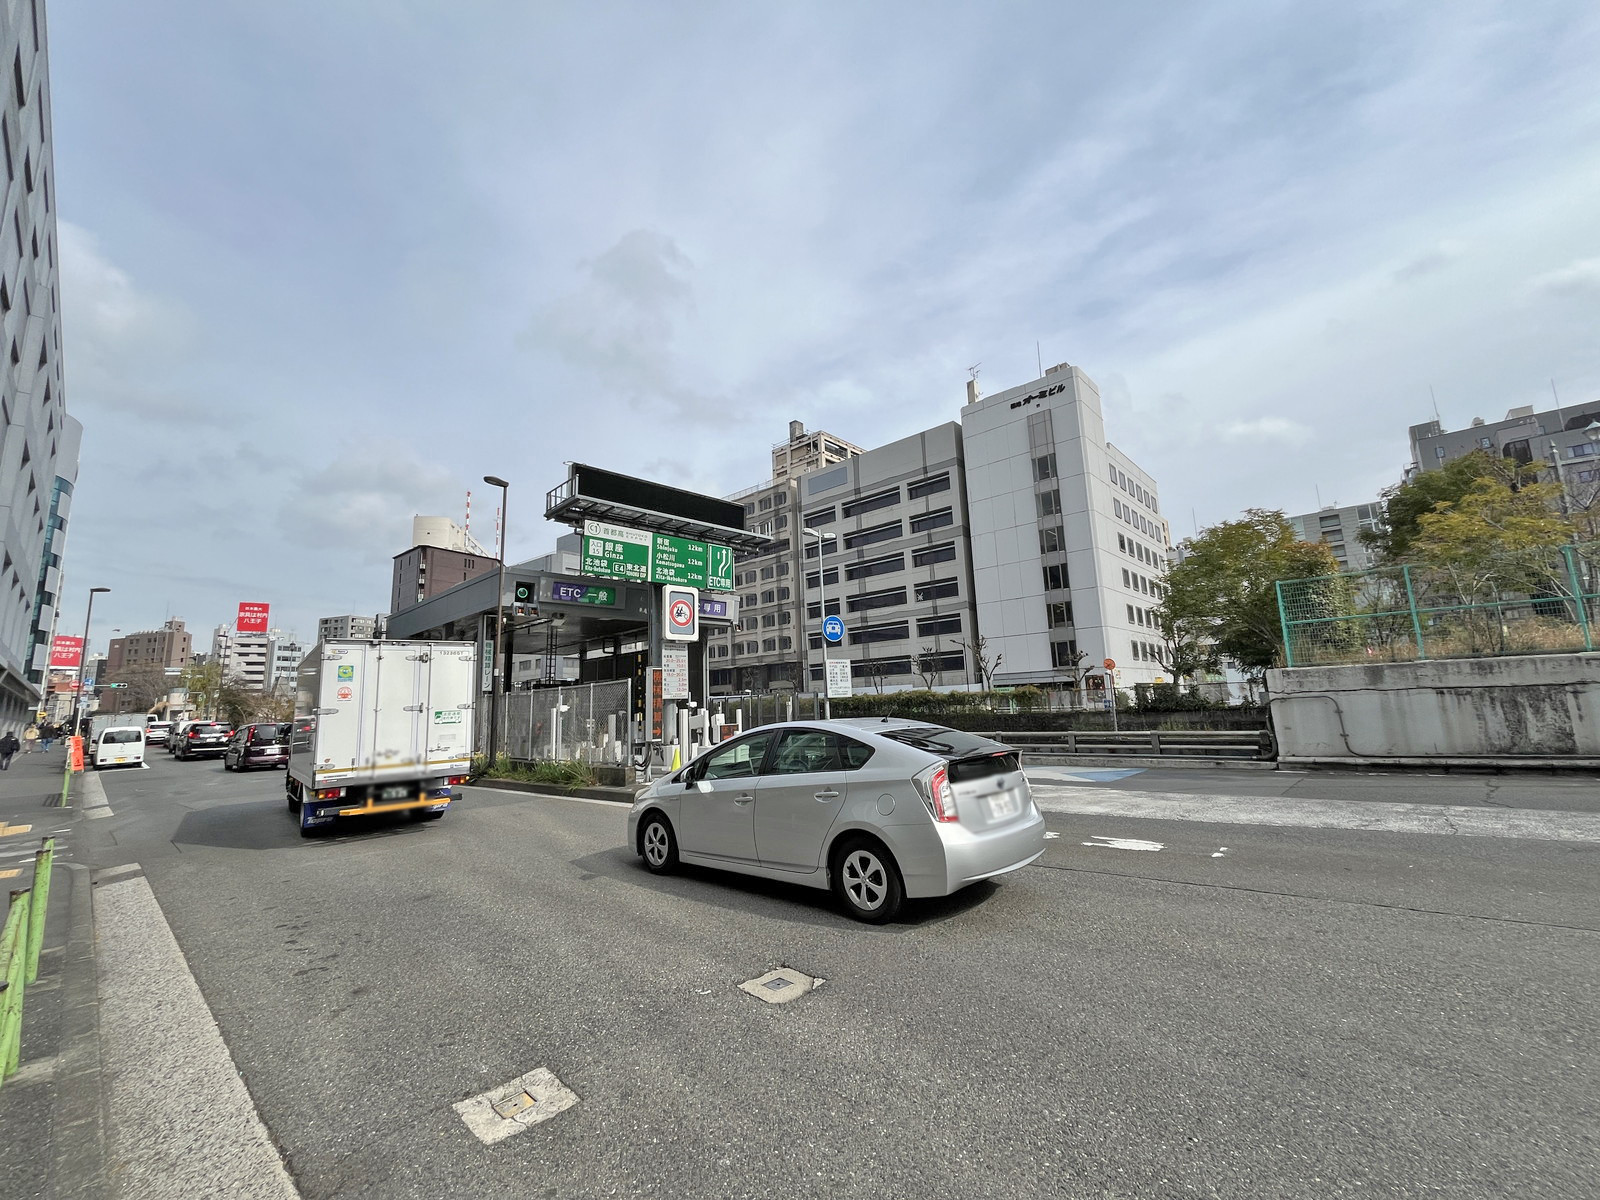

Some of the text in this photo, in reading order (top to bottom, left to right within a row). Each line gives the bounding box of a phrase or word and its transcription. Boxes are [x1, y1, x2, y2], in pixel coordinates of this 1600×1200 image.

[1023, 384, 1065, 406] オーミビル
[603, 527, 624, 538] 首都高
[657, 537, 670, 545] 新宿
[605, 541, 624, 552] 銀座
[657, 545, 678, 553] Shinjuku
[688, 544, 703, 552] 12km
[604, 551, 624, 560] Ginza
[656, 552, 676, 562] 小松川
[585, 558, 608, 568] 北池袋
[614, 564, 624, 572] E4
[626, 563, 647, 573] 東北道
[656, 567, 675, 576] 北池袋
[688, 573, 703, 581] 12km
[709, 576, 731, 588] ETC専用
[560, 587, 608, 602] ETC 一般
